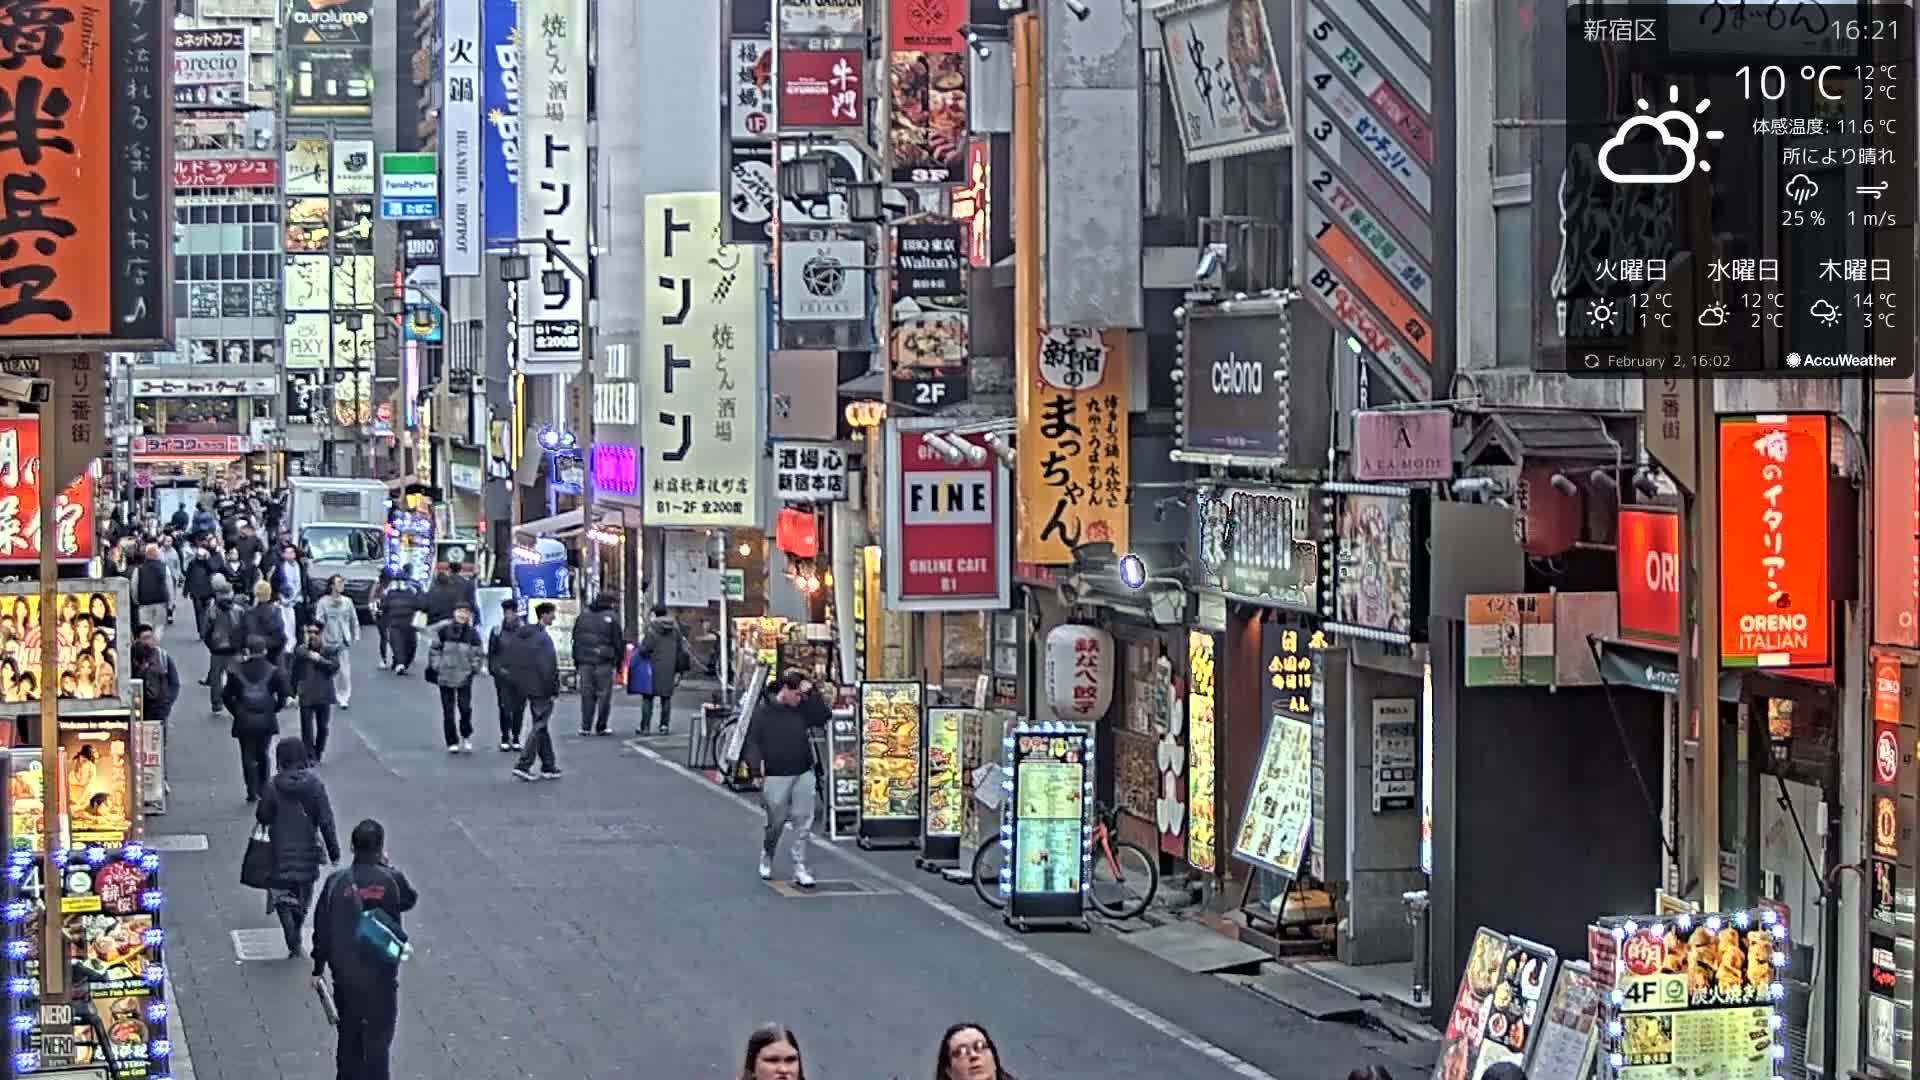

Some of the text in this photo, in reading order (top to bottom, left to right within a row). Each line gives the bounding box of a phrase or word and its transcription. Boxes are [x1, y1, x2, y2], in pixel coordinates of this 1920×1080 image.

[1313, 20, 1334, 41] 5
[449, 37, 475, 103] 火鍋
[828, 57, 858, 119] 牛門
[1313, 73, 1333, 90] 4
[1313, 120, 1333, 141] 3
[911, 168, 950, 183] 3F
[1312, 171, 1333, 192] 2
[1315, 221, 1332, 239] 1
[1311, 268, 1338, 298] B1
[659, 207, 692, 462] トントン
[1211, 351, 1263, 394] celona
[71, 353, 93, 444] 通り一番街
[915, 383, 946, 403] 2F
[778, 449, 843, 469] 酒場心
[1040, 394, 1084, 548] まっちゃん
[778, 474, 843, 492] 新宿本店
[910, 484, 986, 512] FINE
[1753, 429, 1788, 603] 俺のイタリアン
[909, 558, 987, 574] ONLINE CAFE
[1739, 613, 1808, 632] ORENO
[1738, 634, 1809, 651] ITALIAN
[1624, 981, 1657, 1004] 4F
[40, 1004, 72, 1025] NERO
[41, 1035, 75, 1057] NERO
